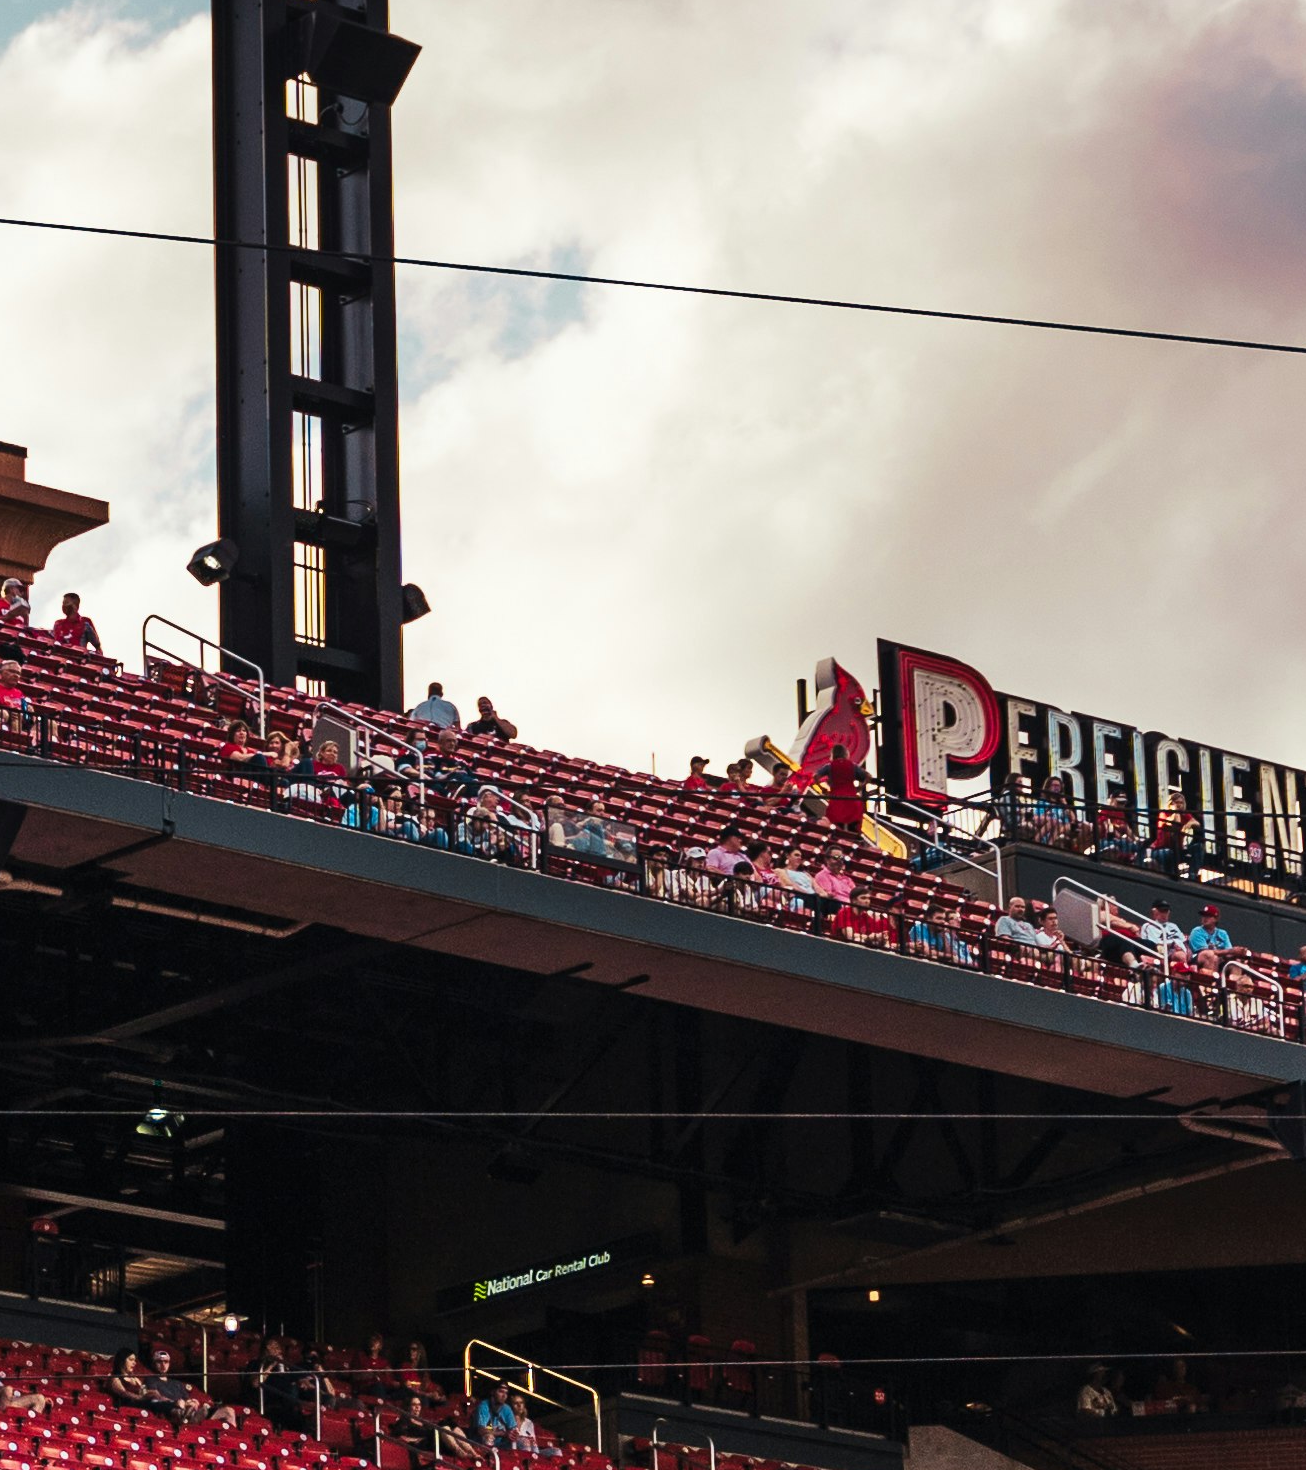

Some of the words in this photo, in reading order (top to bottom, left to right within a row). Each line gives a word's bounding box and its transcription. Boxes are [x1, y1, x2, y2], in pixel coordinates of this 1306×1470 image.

[487, 1269, 533, 1296] National
[536, 1269, 554, 1282] Car
[555, 1257, 586, 1276] Rental
[588, 1251, 611, 1267] Club
